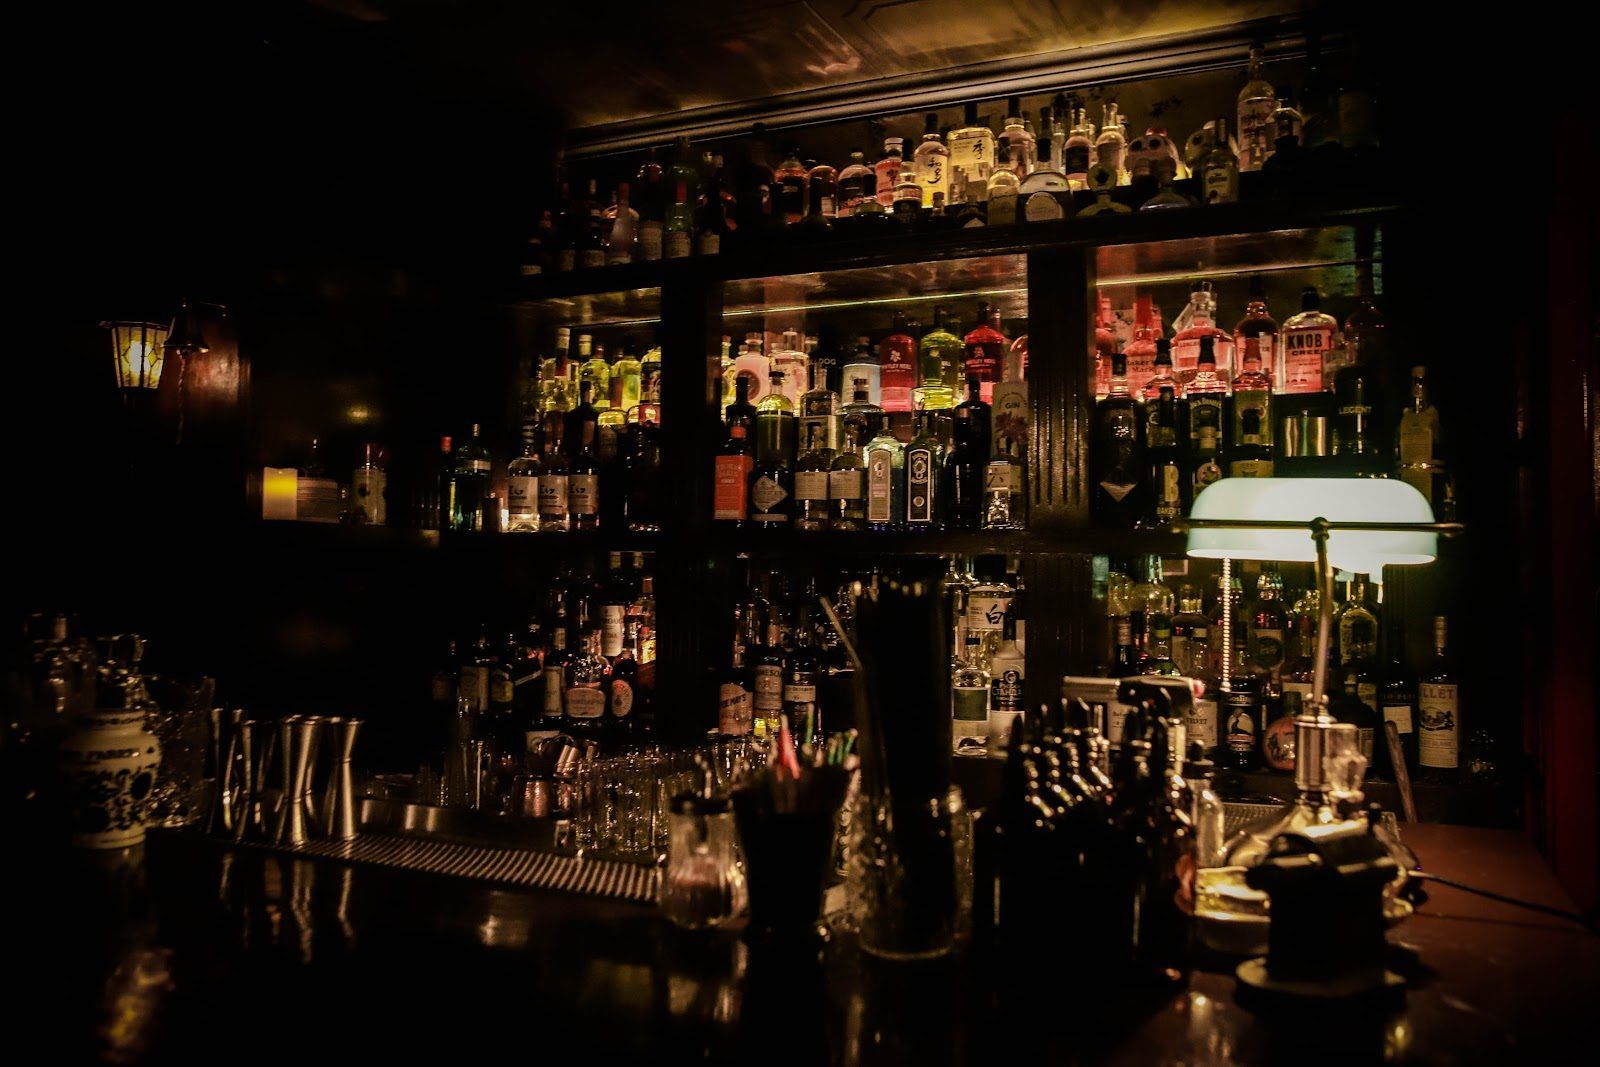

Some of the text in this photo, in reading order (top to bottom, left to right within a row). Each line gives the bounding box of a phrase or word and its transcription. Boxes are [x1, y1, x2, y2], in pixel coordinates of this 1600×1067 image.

[1288, 334, 1322, 349] KNOB
[1163, 465, 1179, 502] B
[986, 604, 1005, 624] 白
[1423, 688, 1454, 699] LLET
